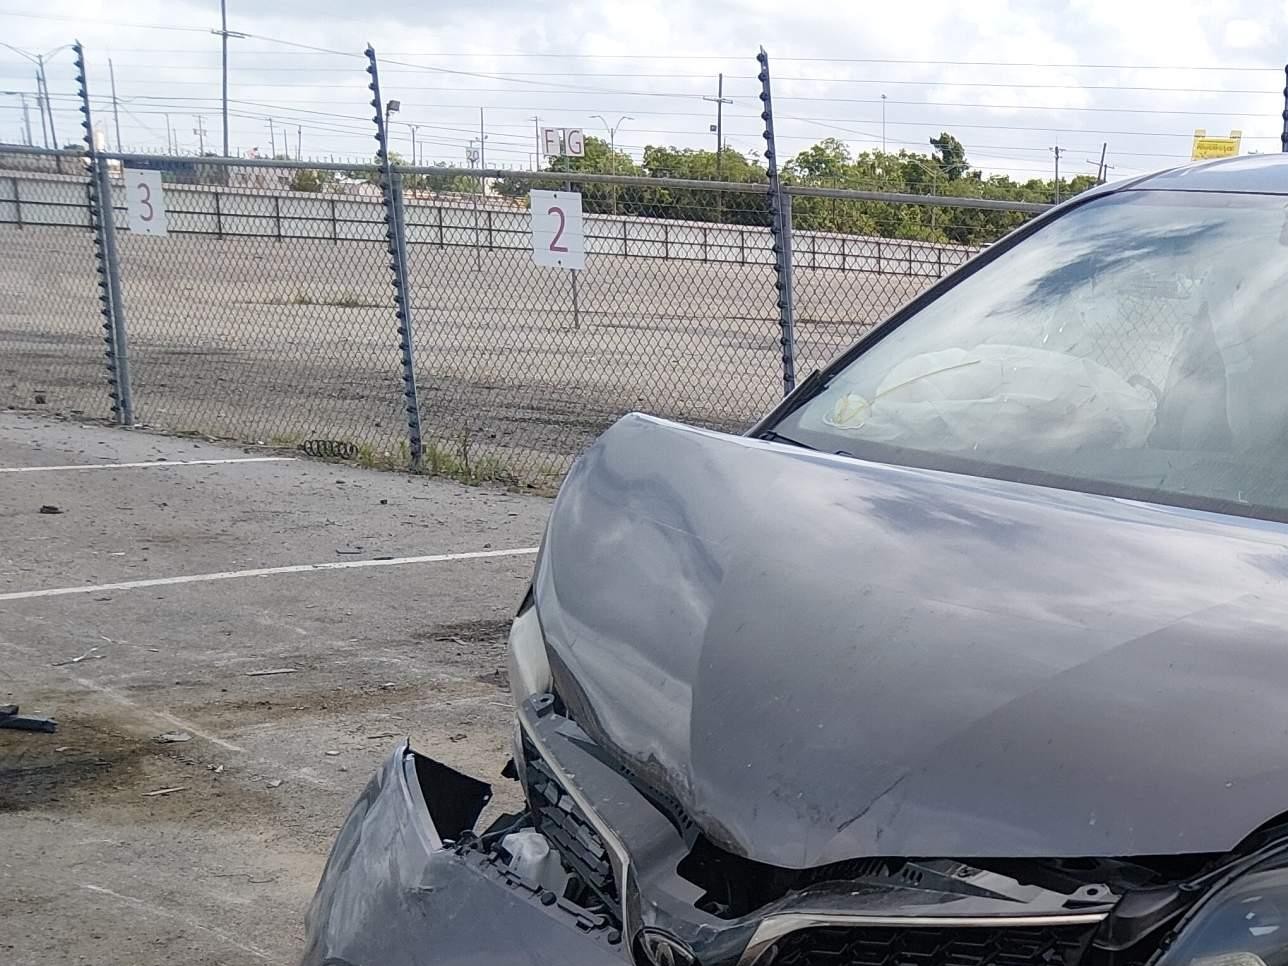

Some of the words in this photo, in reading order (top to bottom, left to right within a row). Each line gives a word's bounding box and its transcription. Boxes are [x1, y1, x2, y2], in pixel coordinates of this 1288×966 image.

[545, 129, 554, 153] F
[568, 130, 582, 154] G
[137, 183, 153, 221] 3
[547, 206, 568, 252] 2
